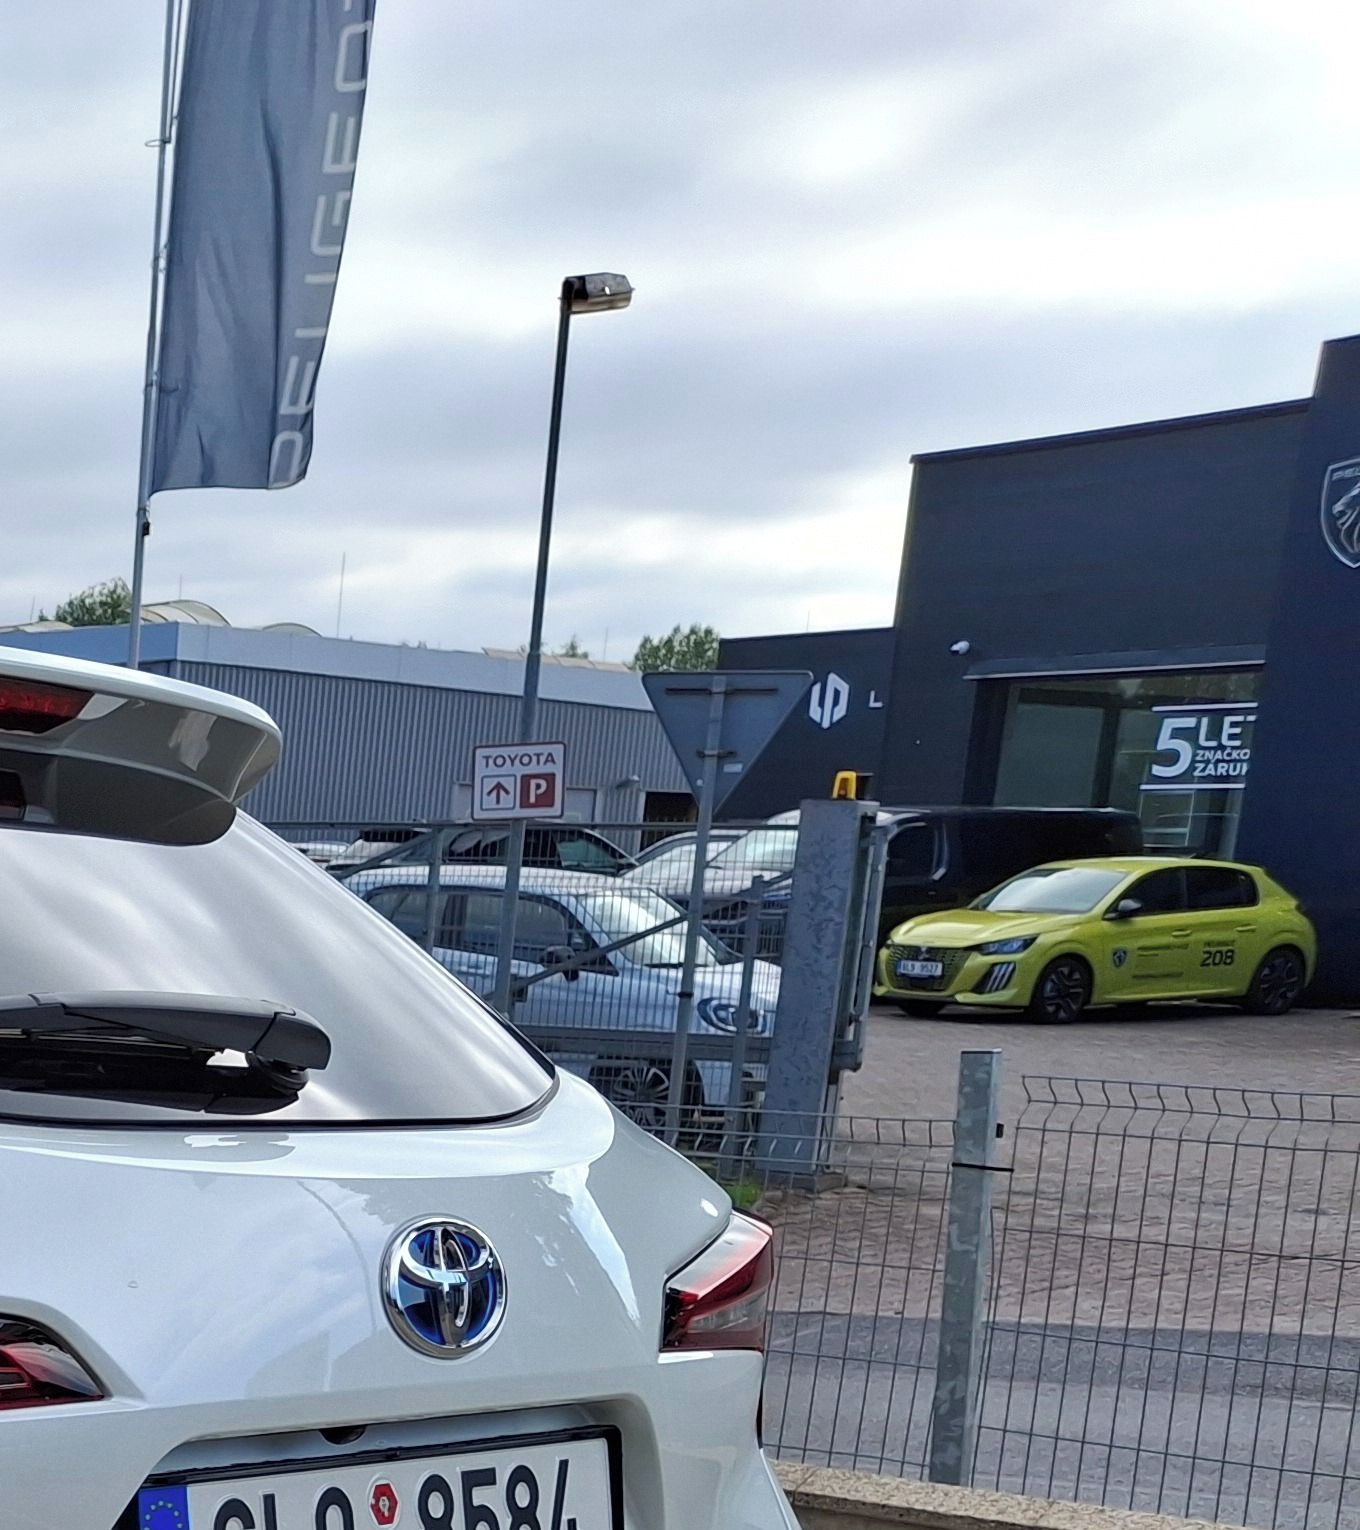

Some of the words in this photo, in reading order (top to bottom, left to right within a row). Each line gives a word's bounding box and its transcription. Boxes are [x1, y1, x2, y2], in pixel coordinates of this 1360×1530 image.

[268, 0, 372, 490] PEUGEO
[482, 752, 556, 768] TOYOTA
[1151, 717, 1197, 777] 5
[529, 778, 548, 804] P
[1200, 949, 1235, 967] 208
